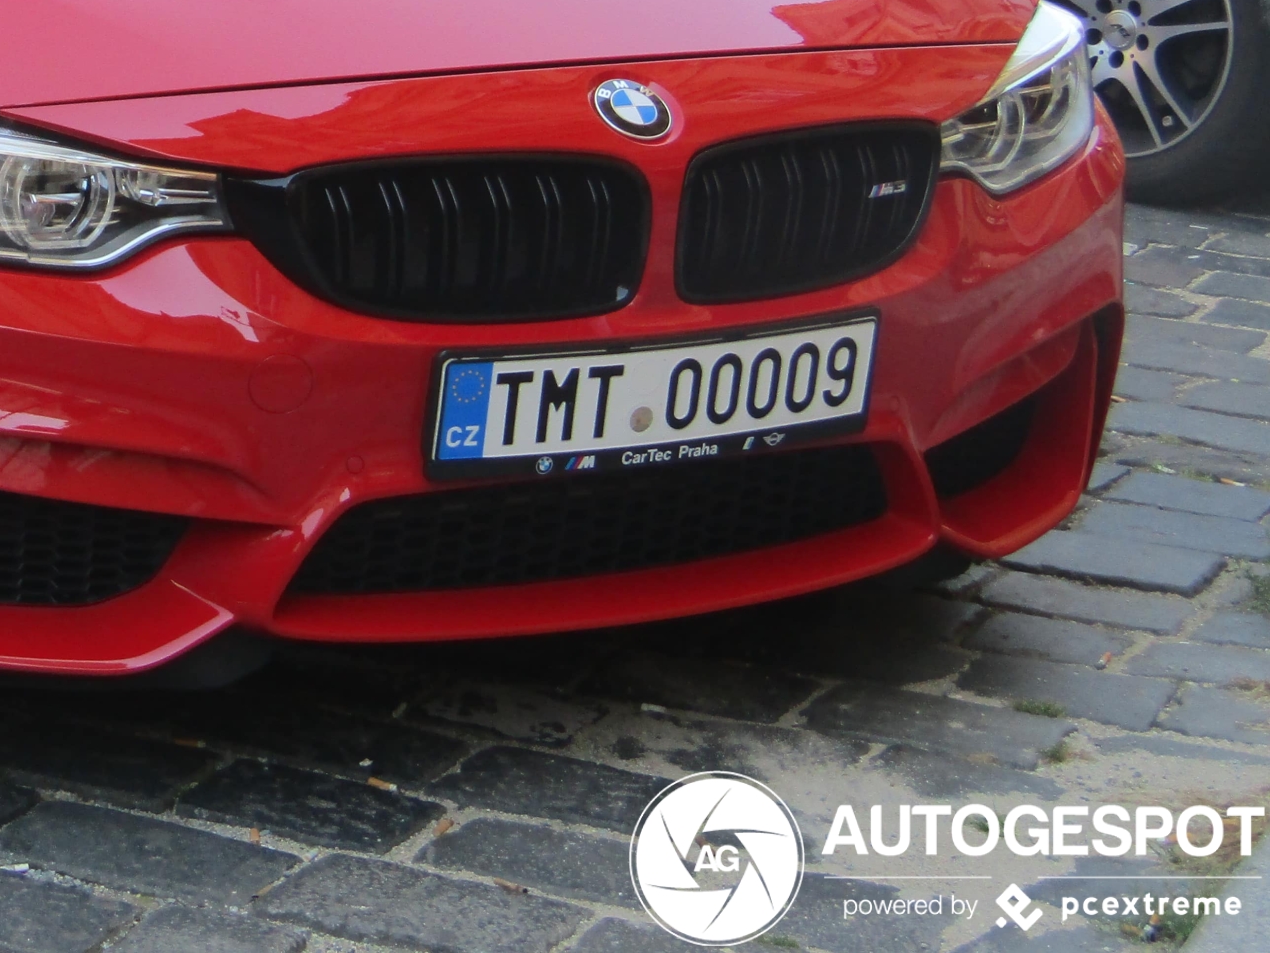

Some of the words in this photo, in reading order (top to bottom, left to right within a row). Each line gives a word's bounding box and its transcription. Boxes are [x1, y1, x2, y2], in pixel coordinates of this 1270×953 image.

[445, 425, 480, 448] CZ
[496, 364, 625, 446] TMT
[665, 336, 858, 430] 00009
[621, 448, 672, 466] CarTec
[678, 442, 718, 459] Praha
